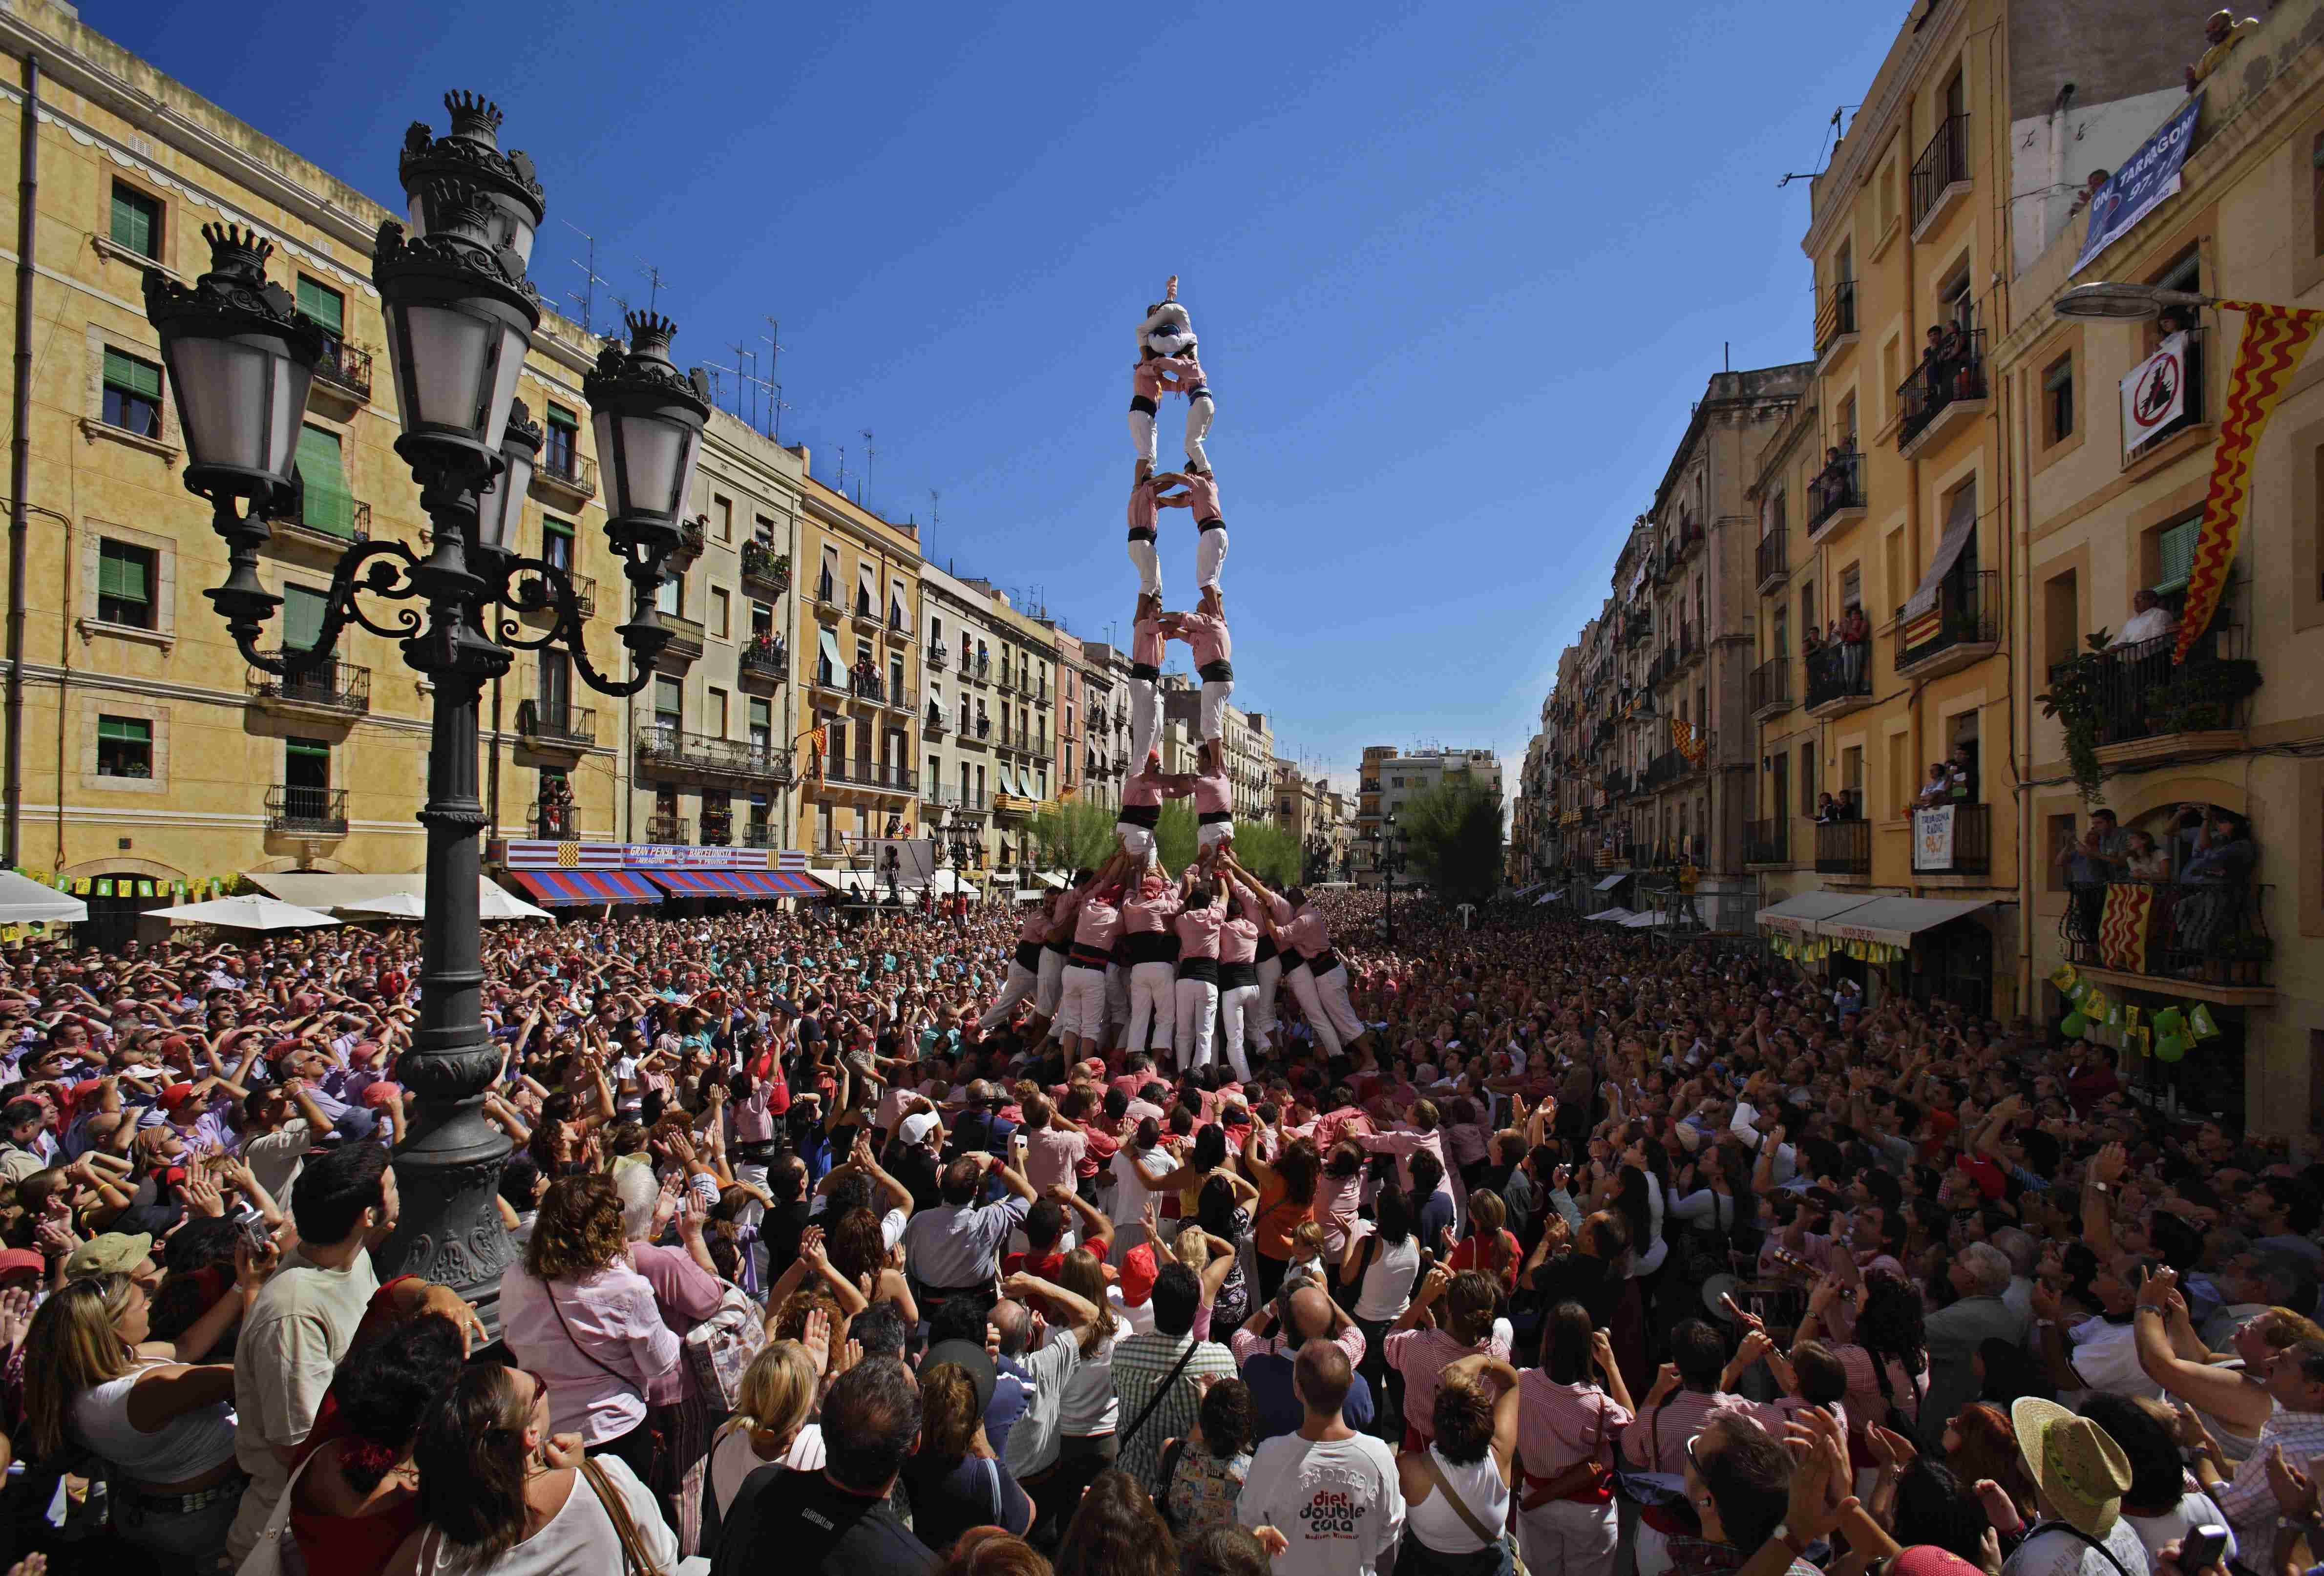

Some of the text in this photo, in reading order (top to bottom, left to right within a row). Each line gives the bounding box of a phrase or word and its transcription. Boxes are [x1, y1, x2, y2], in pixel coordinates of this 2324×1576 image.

[630, 846, 731, 857] GRAN PENYA BARCELONISTA
[1314, 1490, 1347, 1506] diet
[1300, 1502, 1365, 1520] double
[802, 1508, 834, 1531] GLORYDAY.COM
[1311, 1519, 1353, 1532] cola
